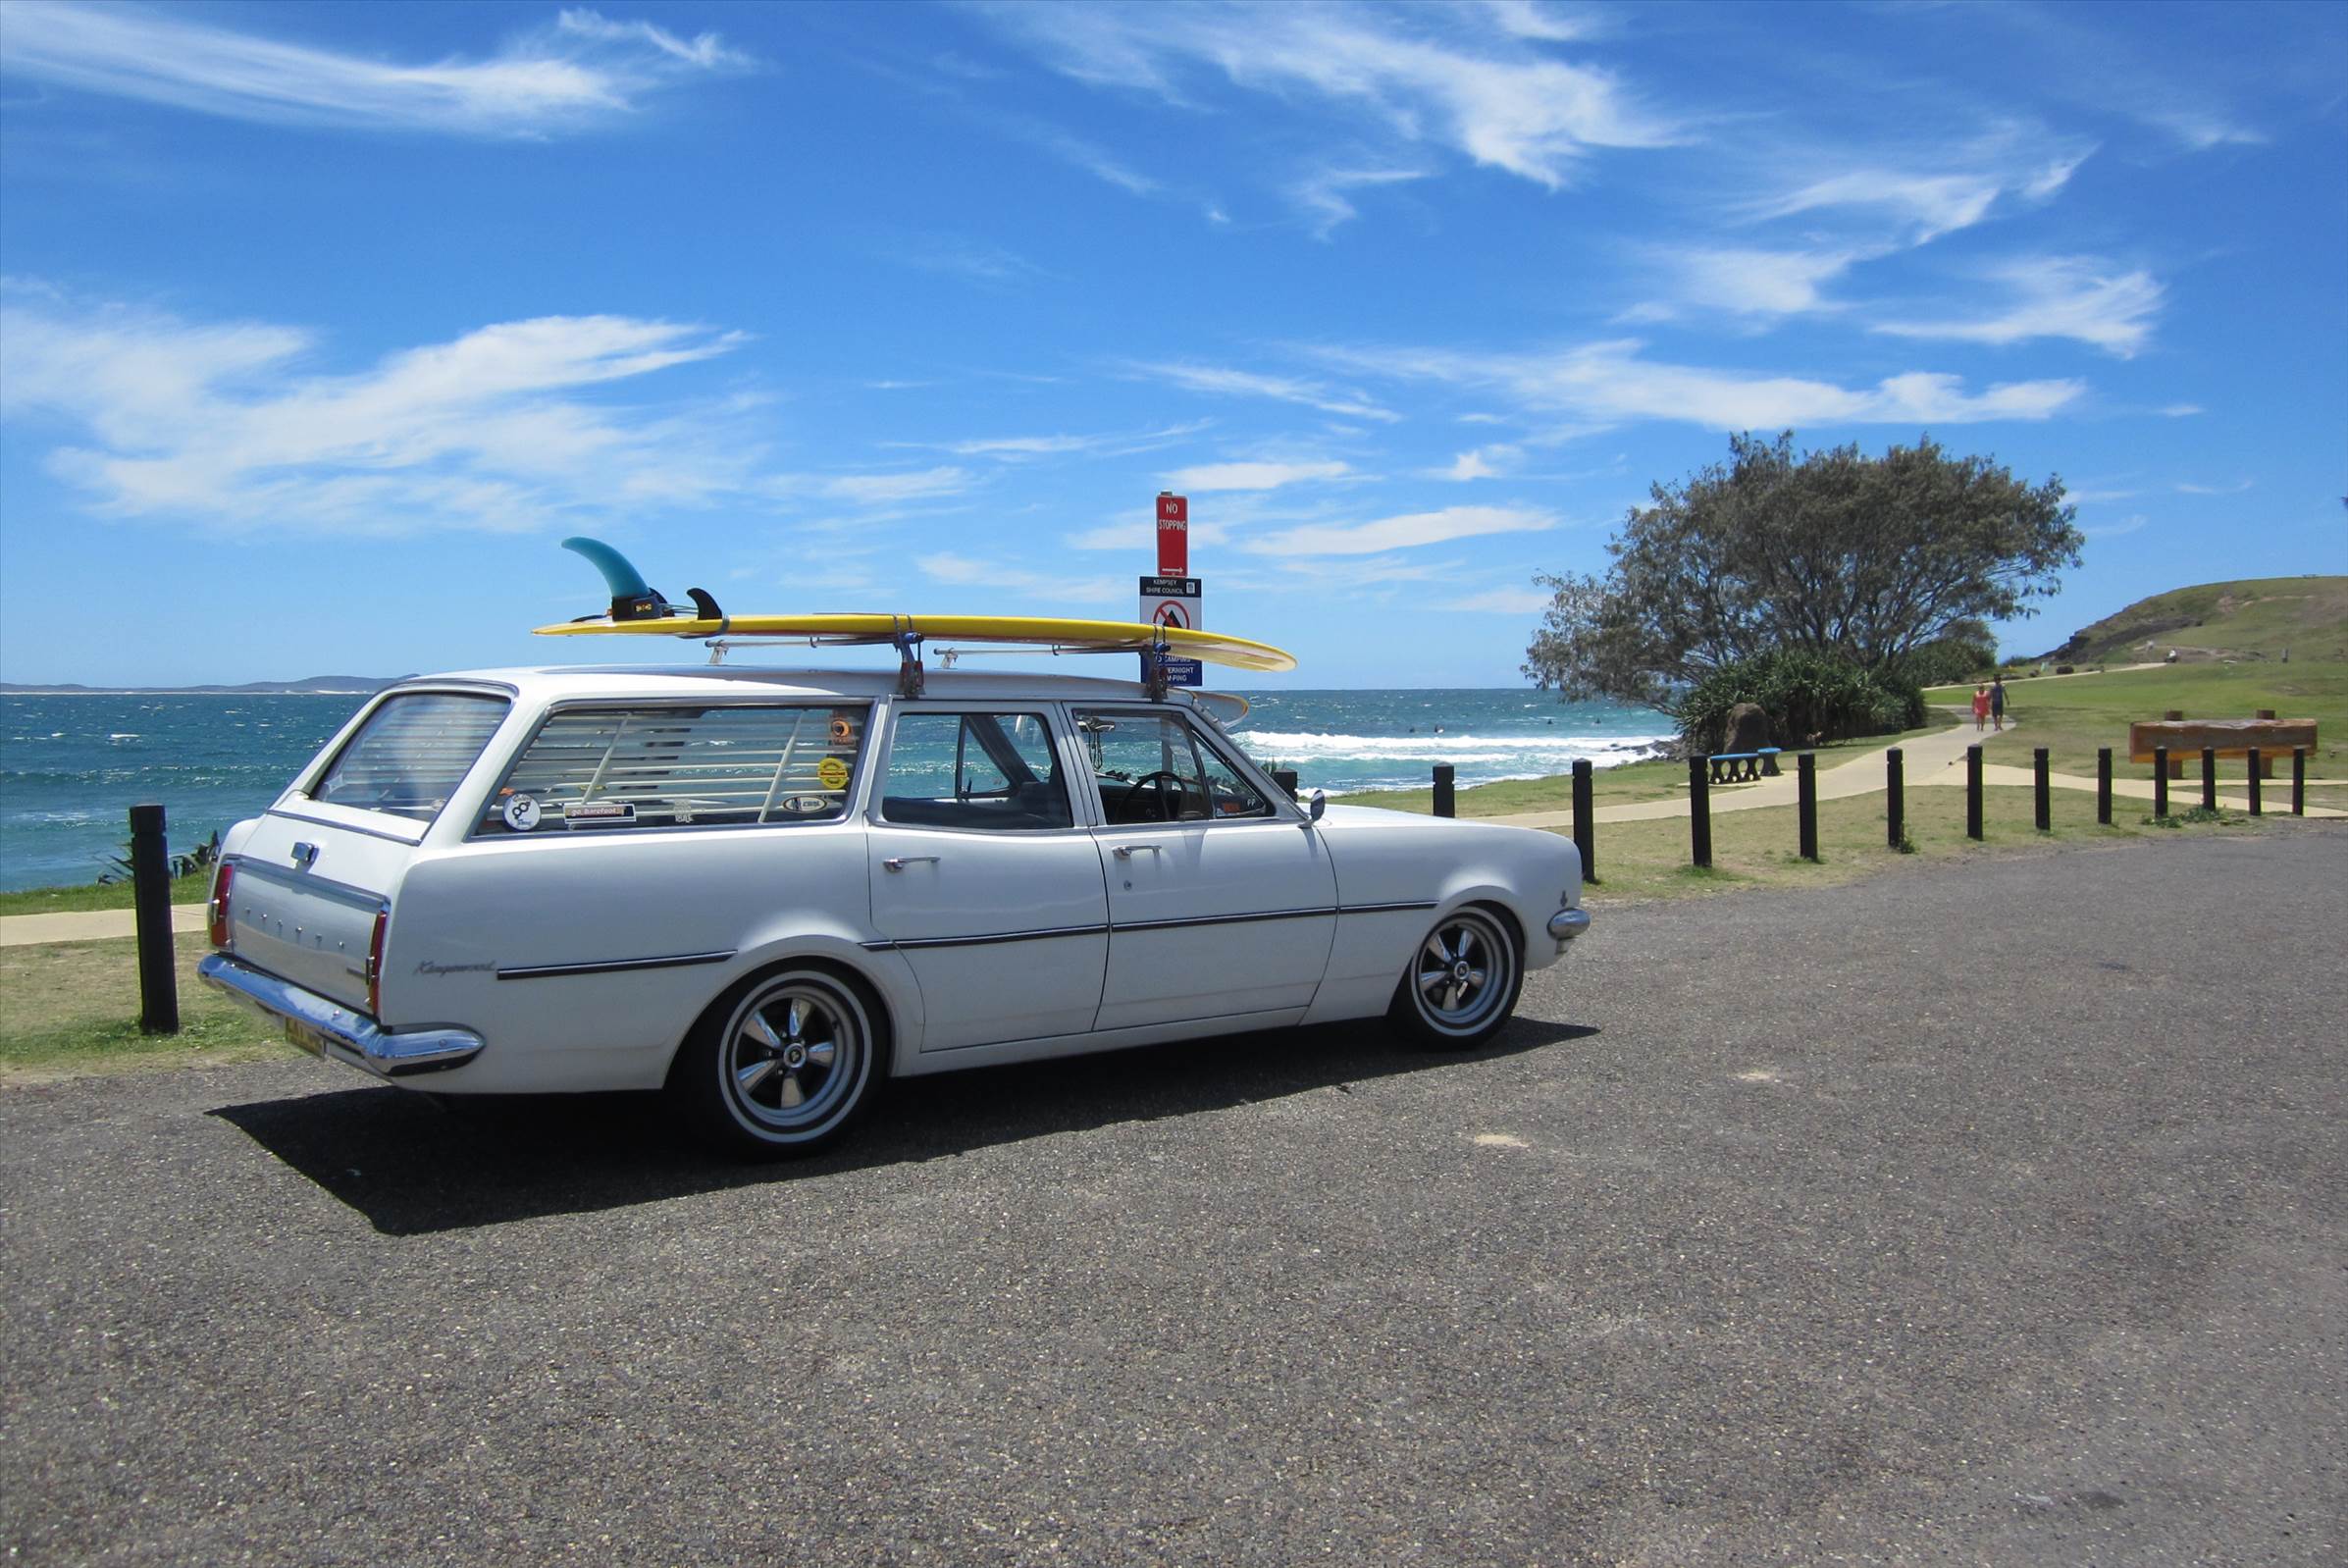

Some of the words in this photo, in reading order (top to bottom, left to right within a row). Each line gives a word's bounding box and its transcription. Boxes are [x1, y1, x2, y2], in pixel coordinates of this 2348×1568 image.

[1166, 503, 1177, 513] NO
[1159, 519, 1186, 531] STOPPING
[584, 807, 617, 815] barefoot
